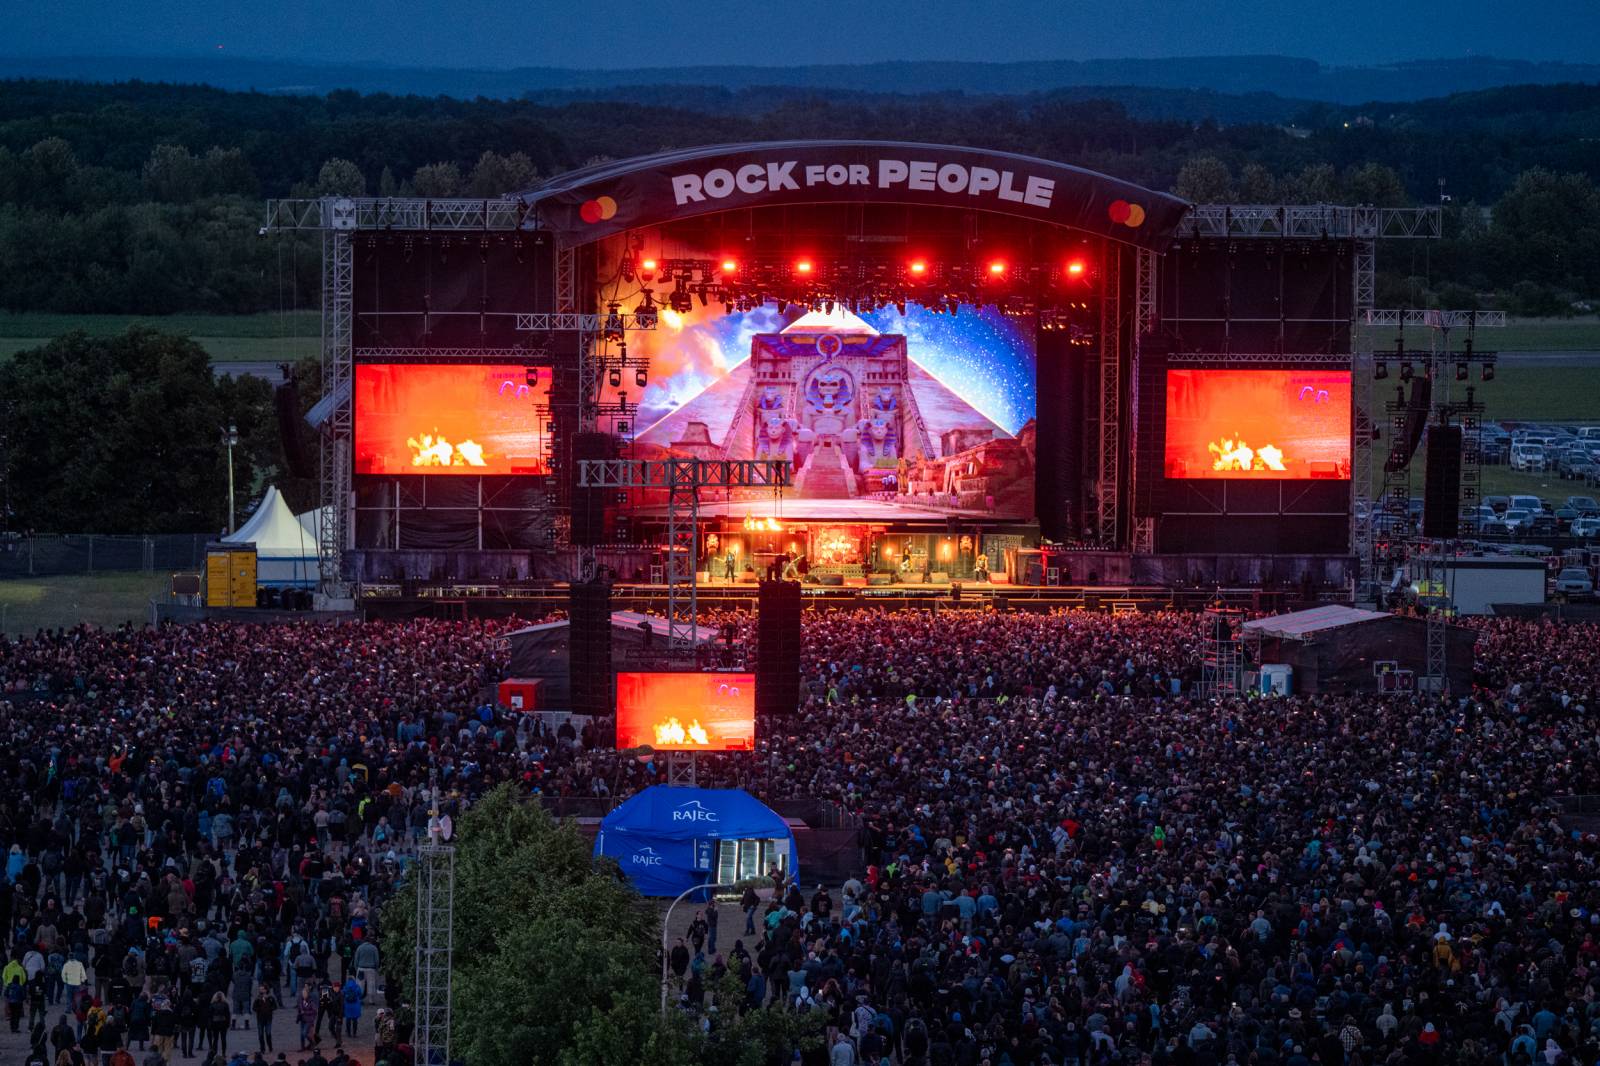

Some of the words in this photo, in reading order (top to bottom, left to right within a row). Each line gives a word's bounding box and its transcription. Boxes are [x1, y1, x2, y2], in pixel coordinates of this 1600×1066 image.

[672, 161, 801, 206] ROCK
[805, 164, 871, 187] FOR
[878, 159, 1056, 209] PEOPLE
[673, 810, 719, 822] RAJEC
[632, 854, 663, 867] RAJEC
